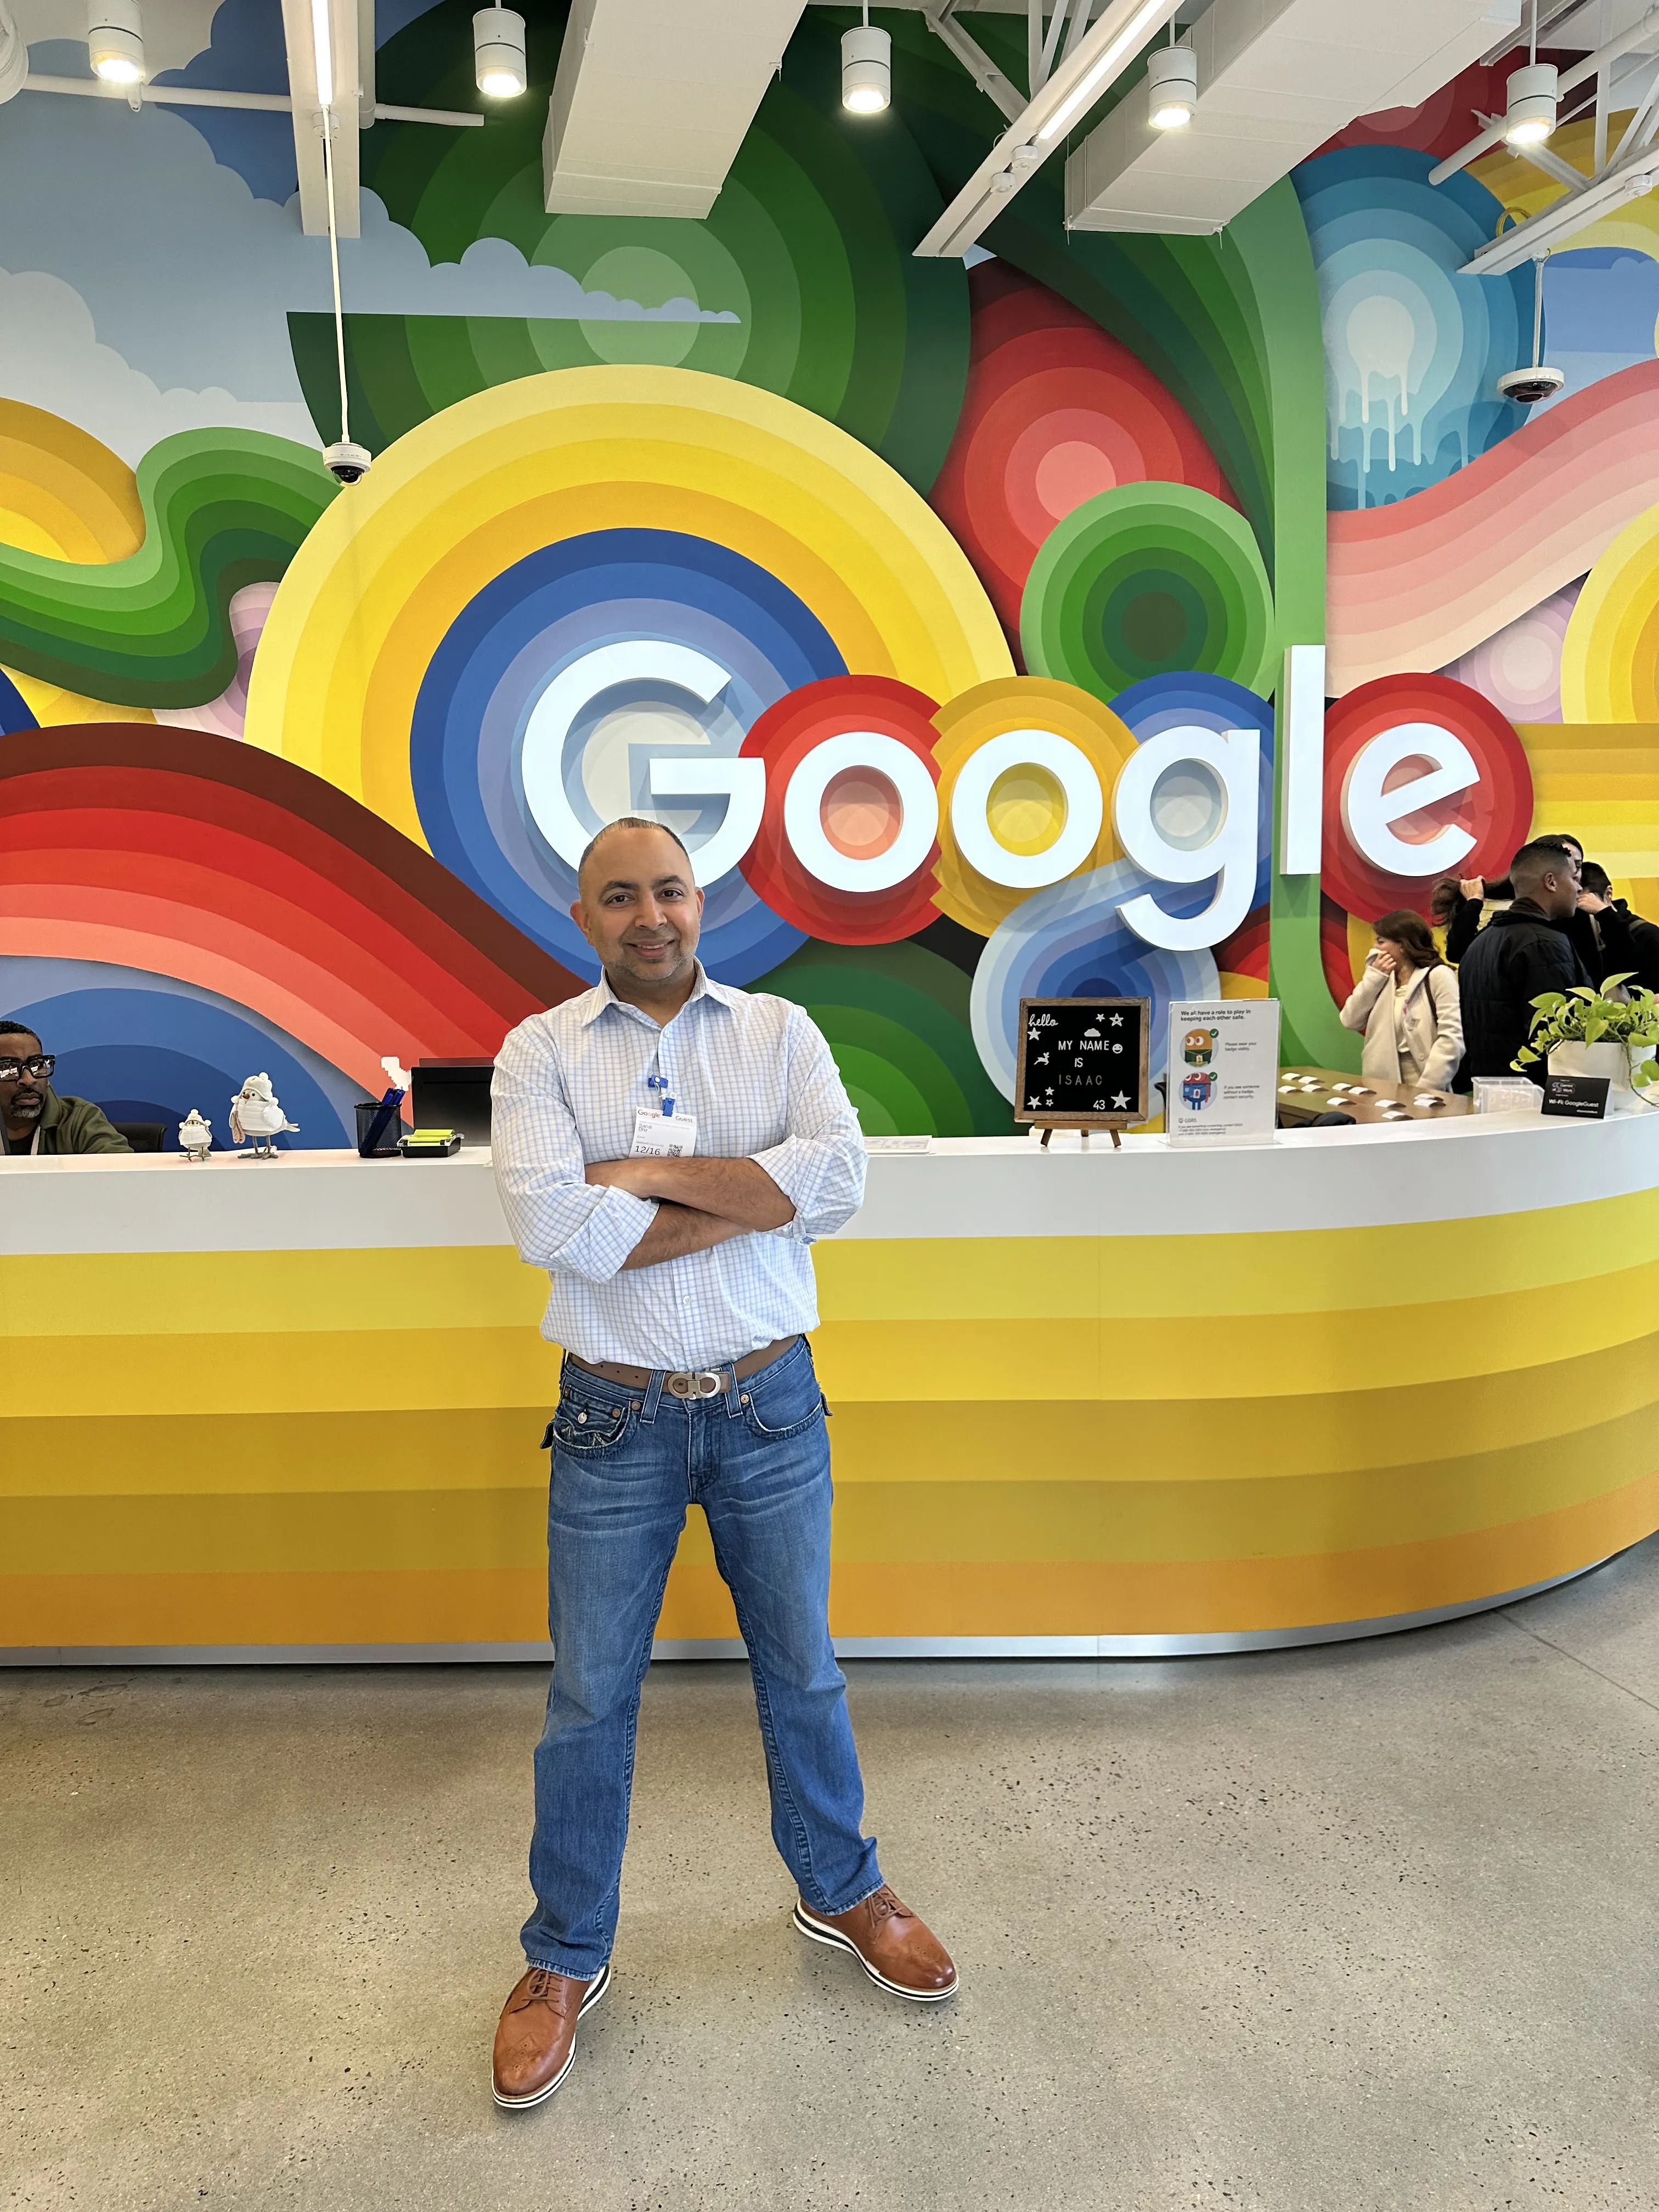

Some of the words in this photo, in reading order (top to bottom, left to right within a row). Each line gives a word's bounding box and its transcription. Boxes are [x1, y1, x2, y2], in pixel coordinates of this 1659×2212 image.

[521, 640, 1480, 951] Google
[1028, 1014, 1058, 1026] hello
[1058, 1041, 1073, 1050] MY
[1080, 1040, 1109, 1051] NAME
[1075, 1058, 1083, 1067] IS
[1059, 1075, 1102, 1086] ISAAC
[1093, 1100, 1105, 1110] 43
[638, 1109, 661, 1119] Google
[635, 1145, 661, 1155] 12/16
